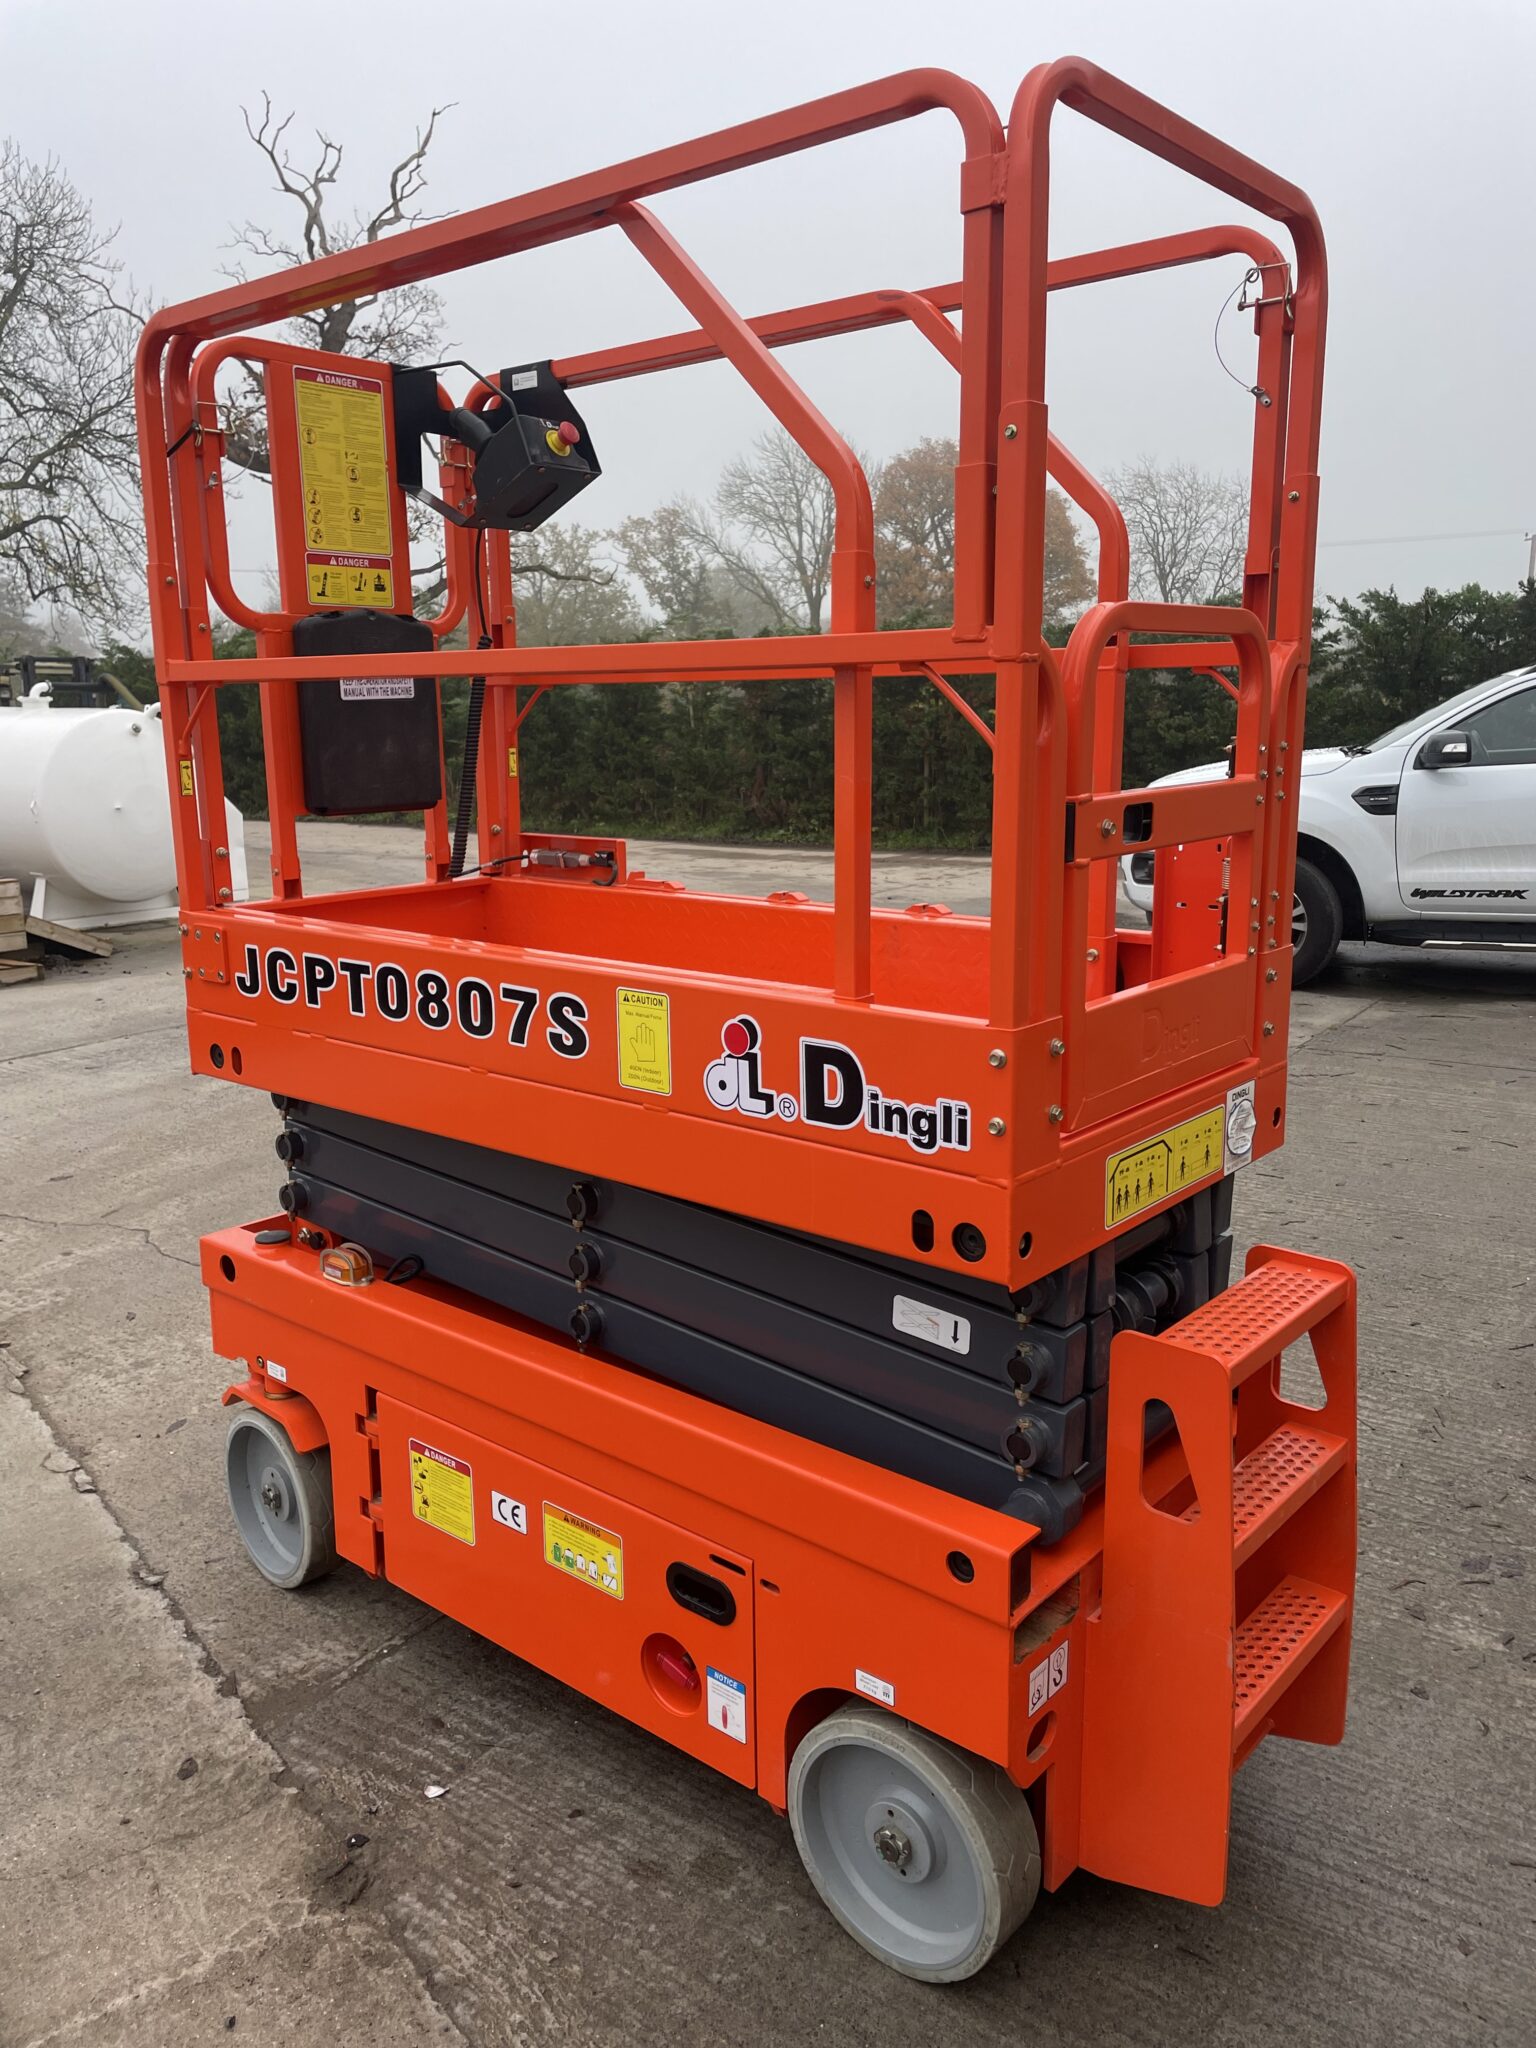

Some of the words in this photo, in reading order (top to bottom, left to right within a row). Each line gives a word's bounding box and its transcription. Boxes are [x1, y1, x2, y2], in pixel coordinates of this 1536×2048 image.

[325, 375, 358, 389] DANGER
[338, 557, 369, 567] DANGER
[344, 687, 365, 697] MANUAL
[366, 687, 379, 696] WITH
[380, 686, 389, 696] THE
[390, 686, 412, 696] MACHINE
[1410, 888, 1529, 899] WILDTRAK
[235, 944, 589, 1060] JCPT0807S
[630, 994, 663, 1007] CAUTION
[801, 1037, 970, 1153] Dingli
[1232, 1086, 1250, 1102] DINGLI
[430, 1450, 456, 1469] DANGER
[498, 1498, 521, 1528] CE
[571, 1518, 601, 1538] WARNING
[714, 1671, 738, 1689] NOTICE
